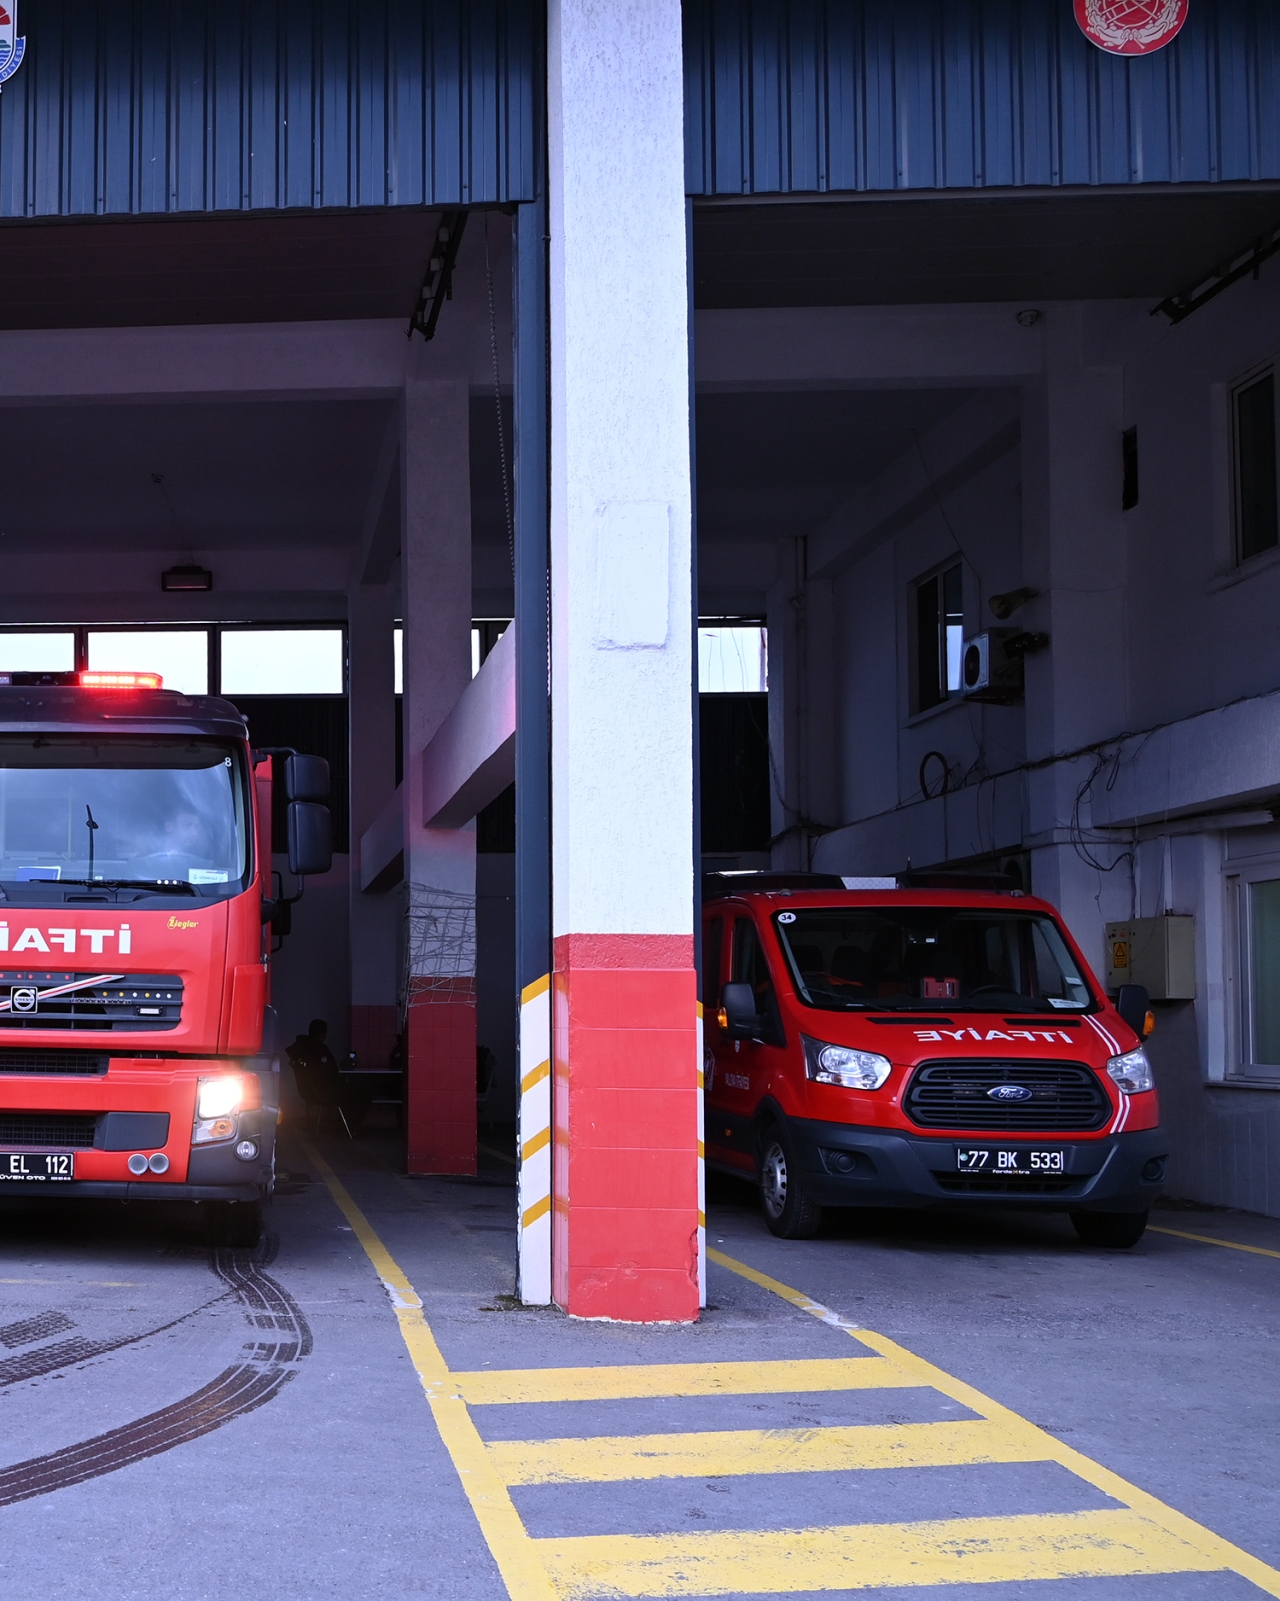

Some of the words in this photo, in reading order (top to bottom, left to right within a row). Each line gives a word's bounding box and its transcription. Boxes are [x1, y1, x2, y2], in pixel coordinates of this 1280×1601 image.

[224, 756, 232, 767] 8
[166, 916, 199, 930] Ziegler
[998, 1087, 1023, 1098] Ford
[9, 1155, 30, 1173] EL
[45, 1155, 68, 1174] 112
[968, 1150, 989, 1167] 77
[997, 1151, 1018, 1168] BK
[1030, 1152, 1061, 1169] 533
